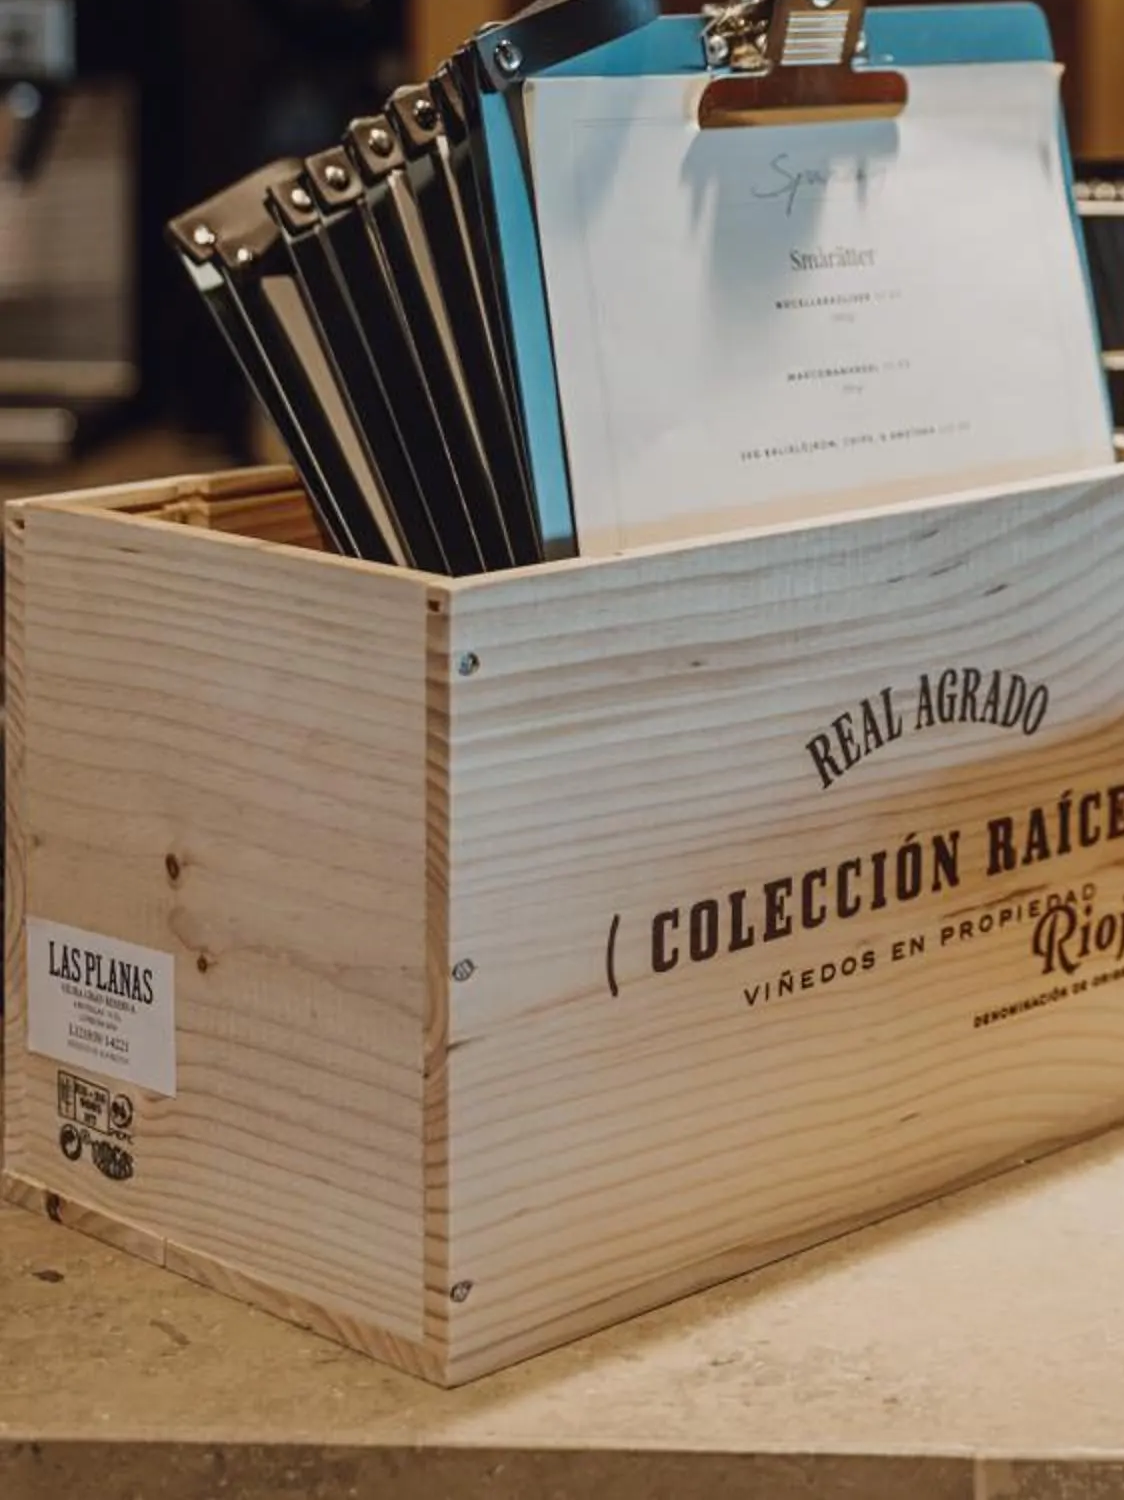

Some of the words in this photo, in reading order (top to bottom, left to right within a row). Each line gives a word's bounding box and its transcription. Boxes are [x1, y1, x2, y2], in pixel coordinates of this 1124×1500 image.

[804, 686, 904, 790] REAL
[914, 666, 1049, 736] AGRADO
[651, 830, 961, 974] COLECCIÓN
[743, 950, 877, 1006] VIÑEDOS
[890, 934, 926, 963] EN
[939, 882, 1096, 946] PROPIEDAD
[49, 940, 81, 983] LAS
[84, 949, 153, 1005] PLANAS
[1072, 980, 1088, 995] DE
